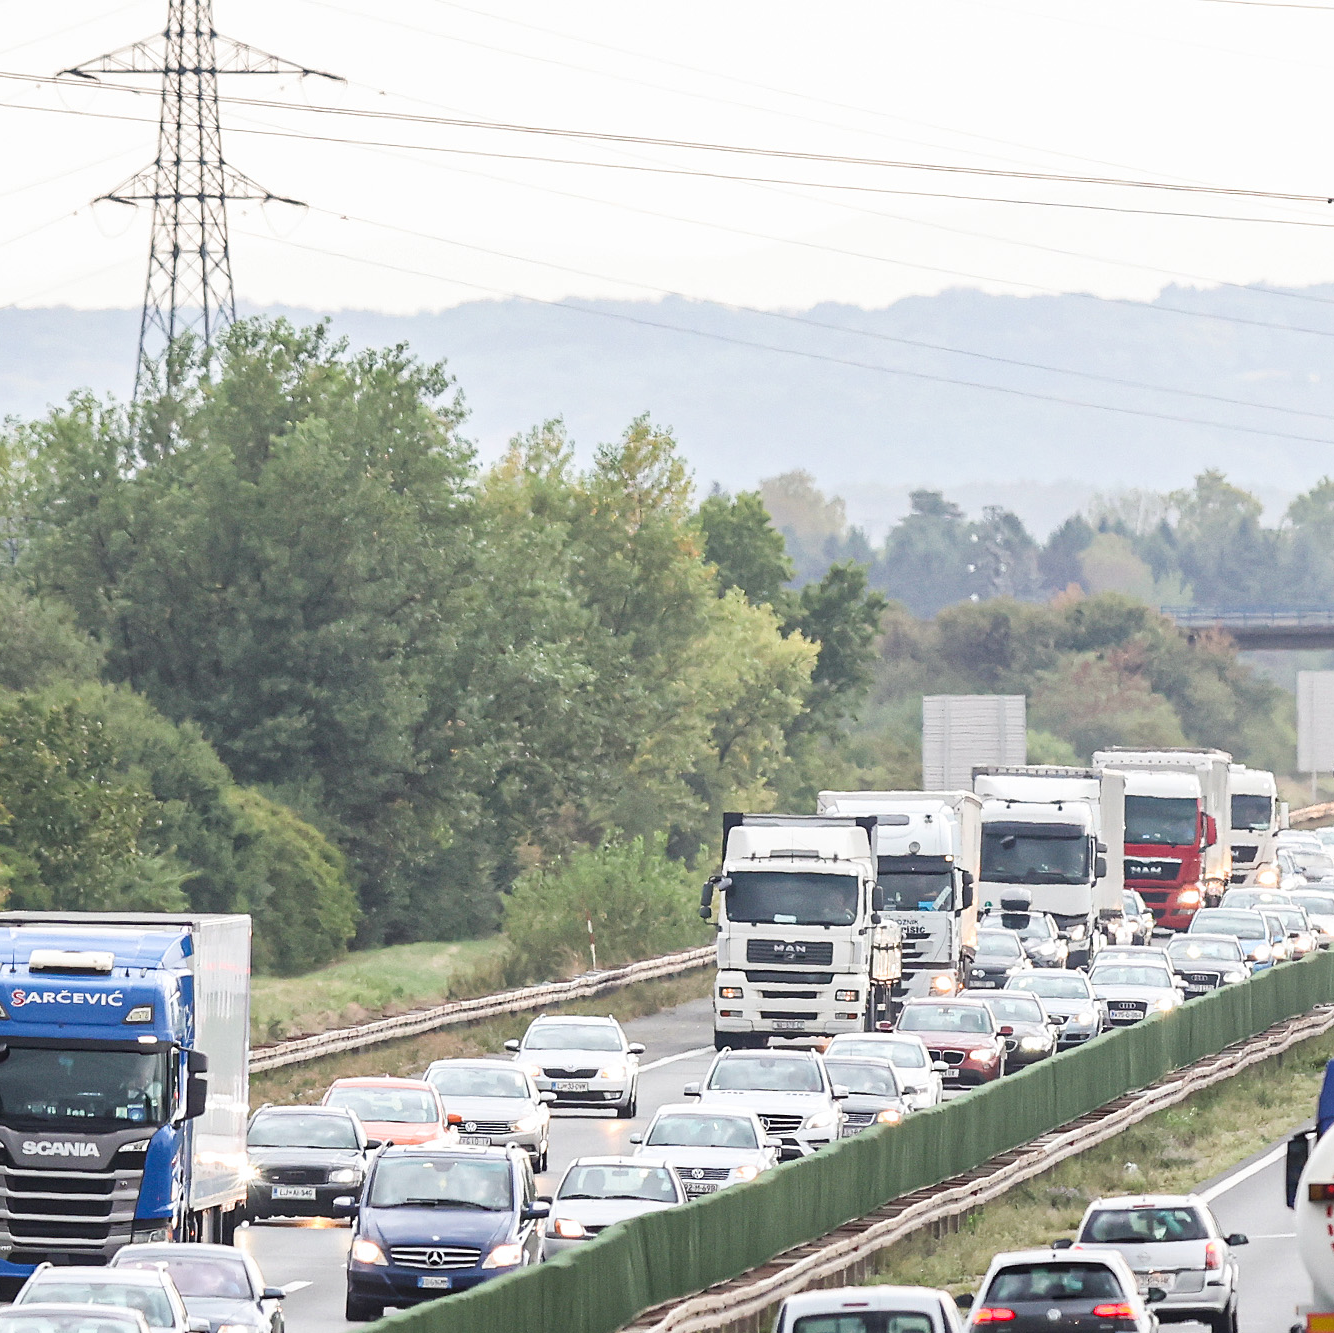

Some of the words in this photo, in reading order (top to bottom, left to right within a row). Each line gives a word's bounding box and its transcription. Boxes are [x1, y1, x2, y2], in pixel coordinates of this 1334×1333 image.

[773, 944, 807, 953] MAN
[10, 988, 124, 1007] SARČEVIĆ
[22, 1141, 101, 1157] SCANIA
